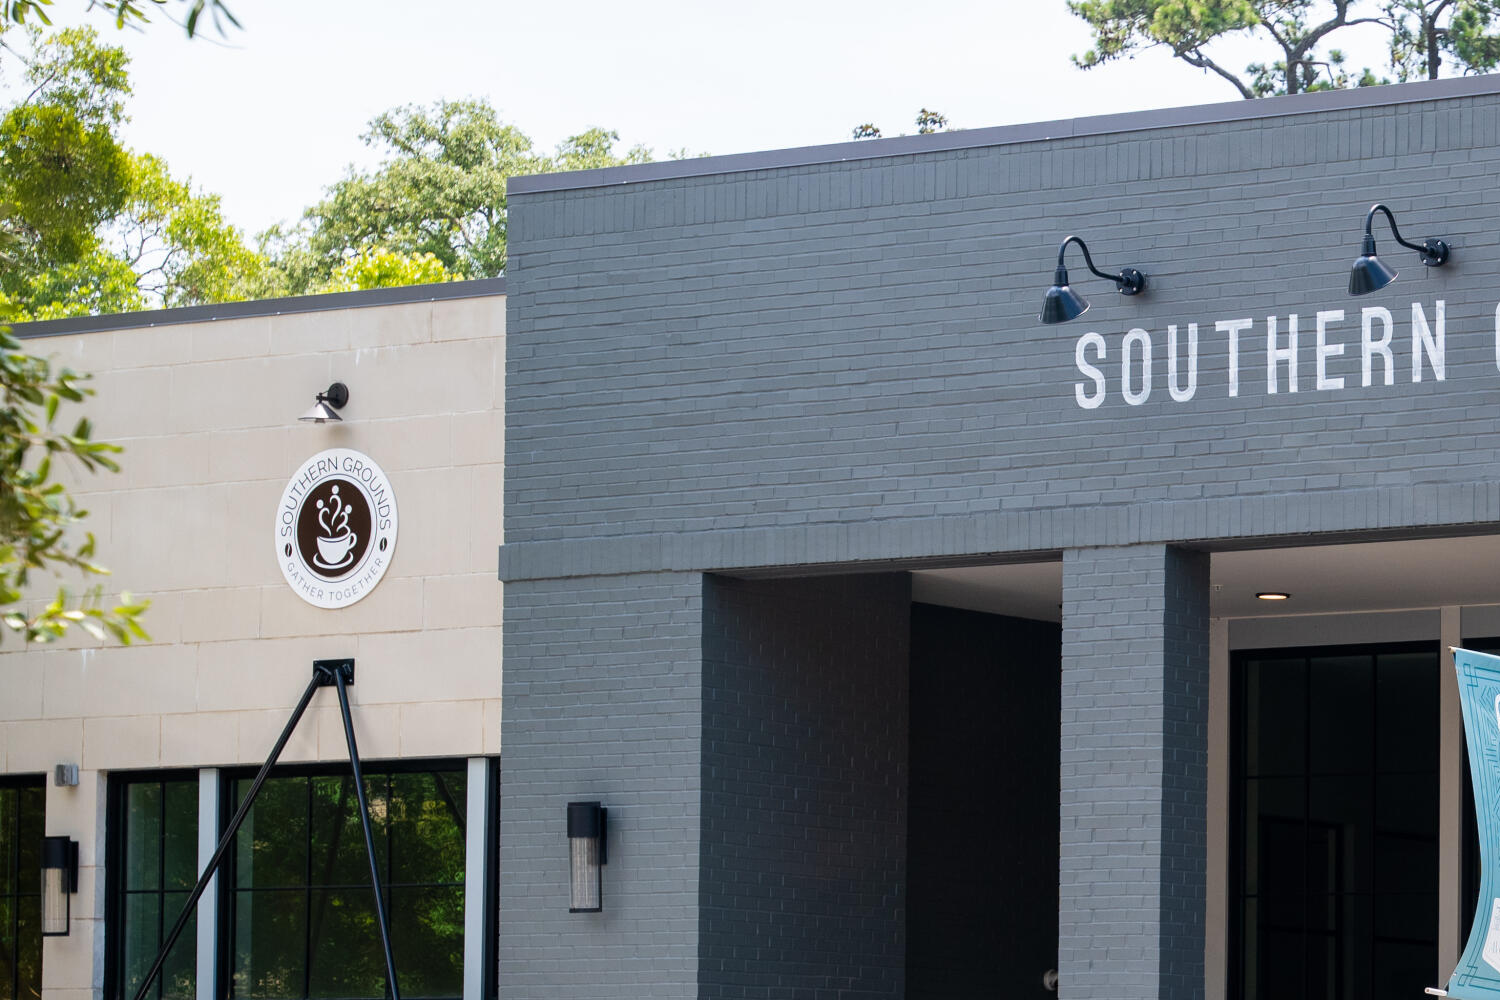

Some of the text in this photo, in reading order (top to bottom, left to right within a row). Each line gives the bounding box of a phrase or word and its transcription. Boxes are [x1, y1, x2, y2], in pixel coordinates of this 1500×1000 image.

[1074, 300, 1446, 409] SOUTHERN
[281, 456, 391, 537] SOUTHERN GROUNDS
[287, 558, 383, 601] GATHER TOGETHER
